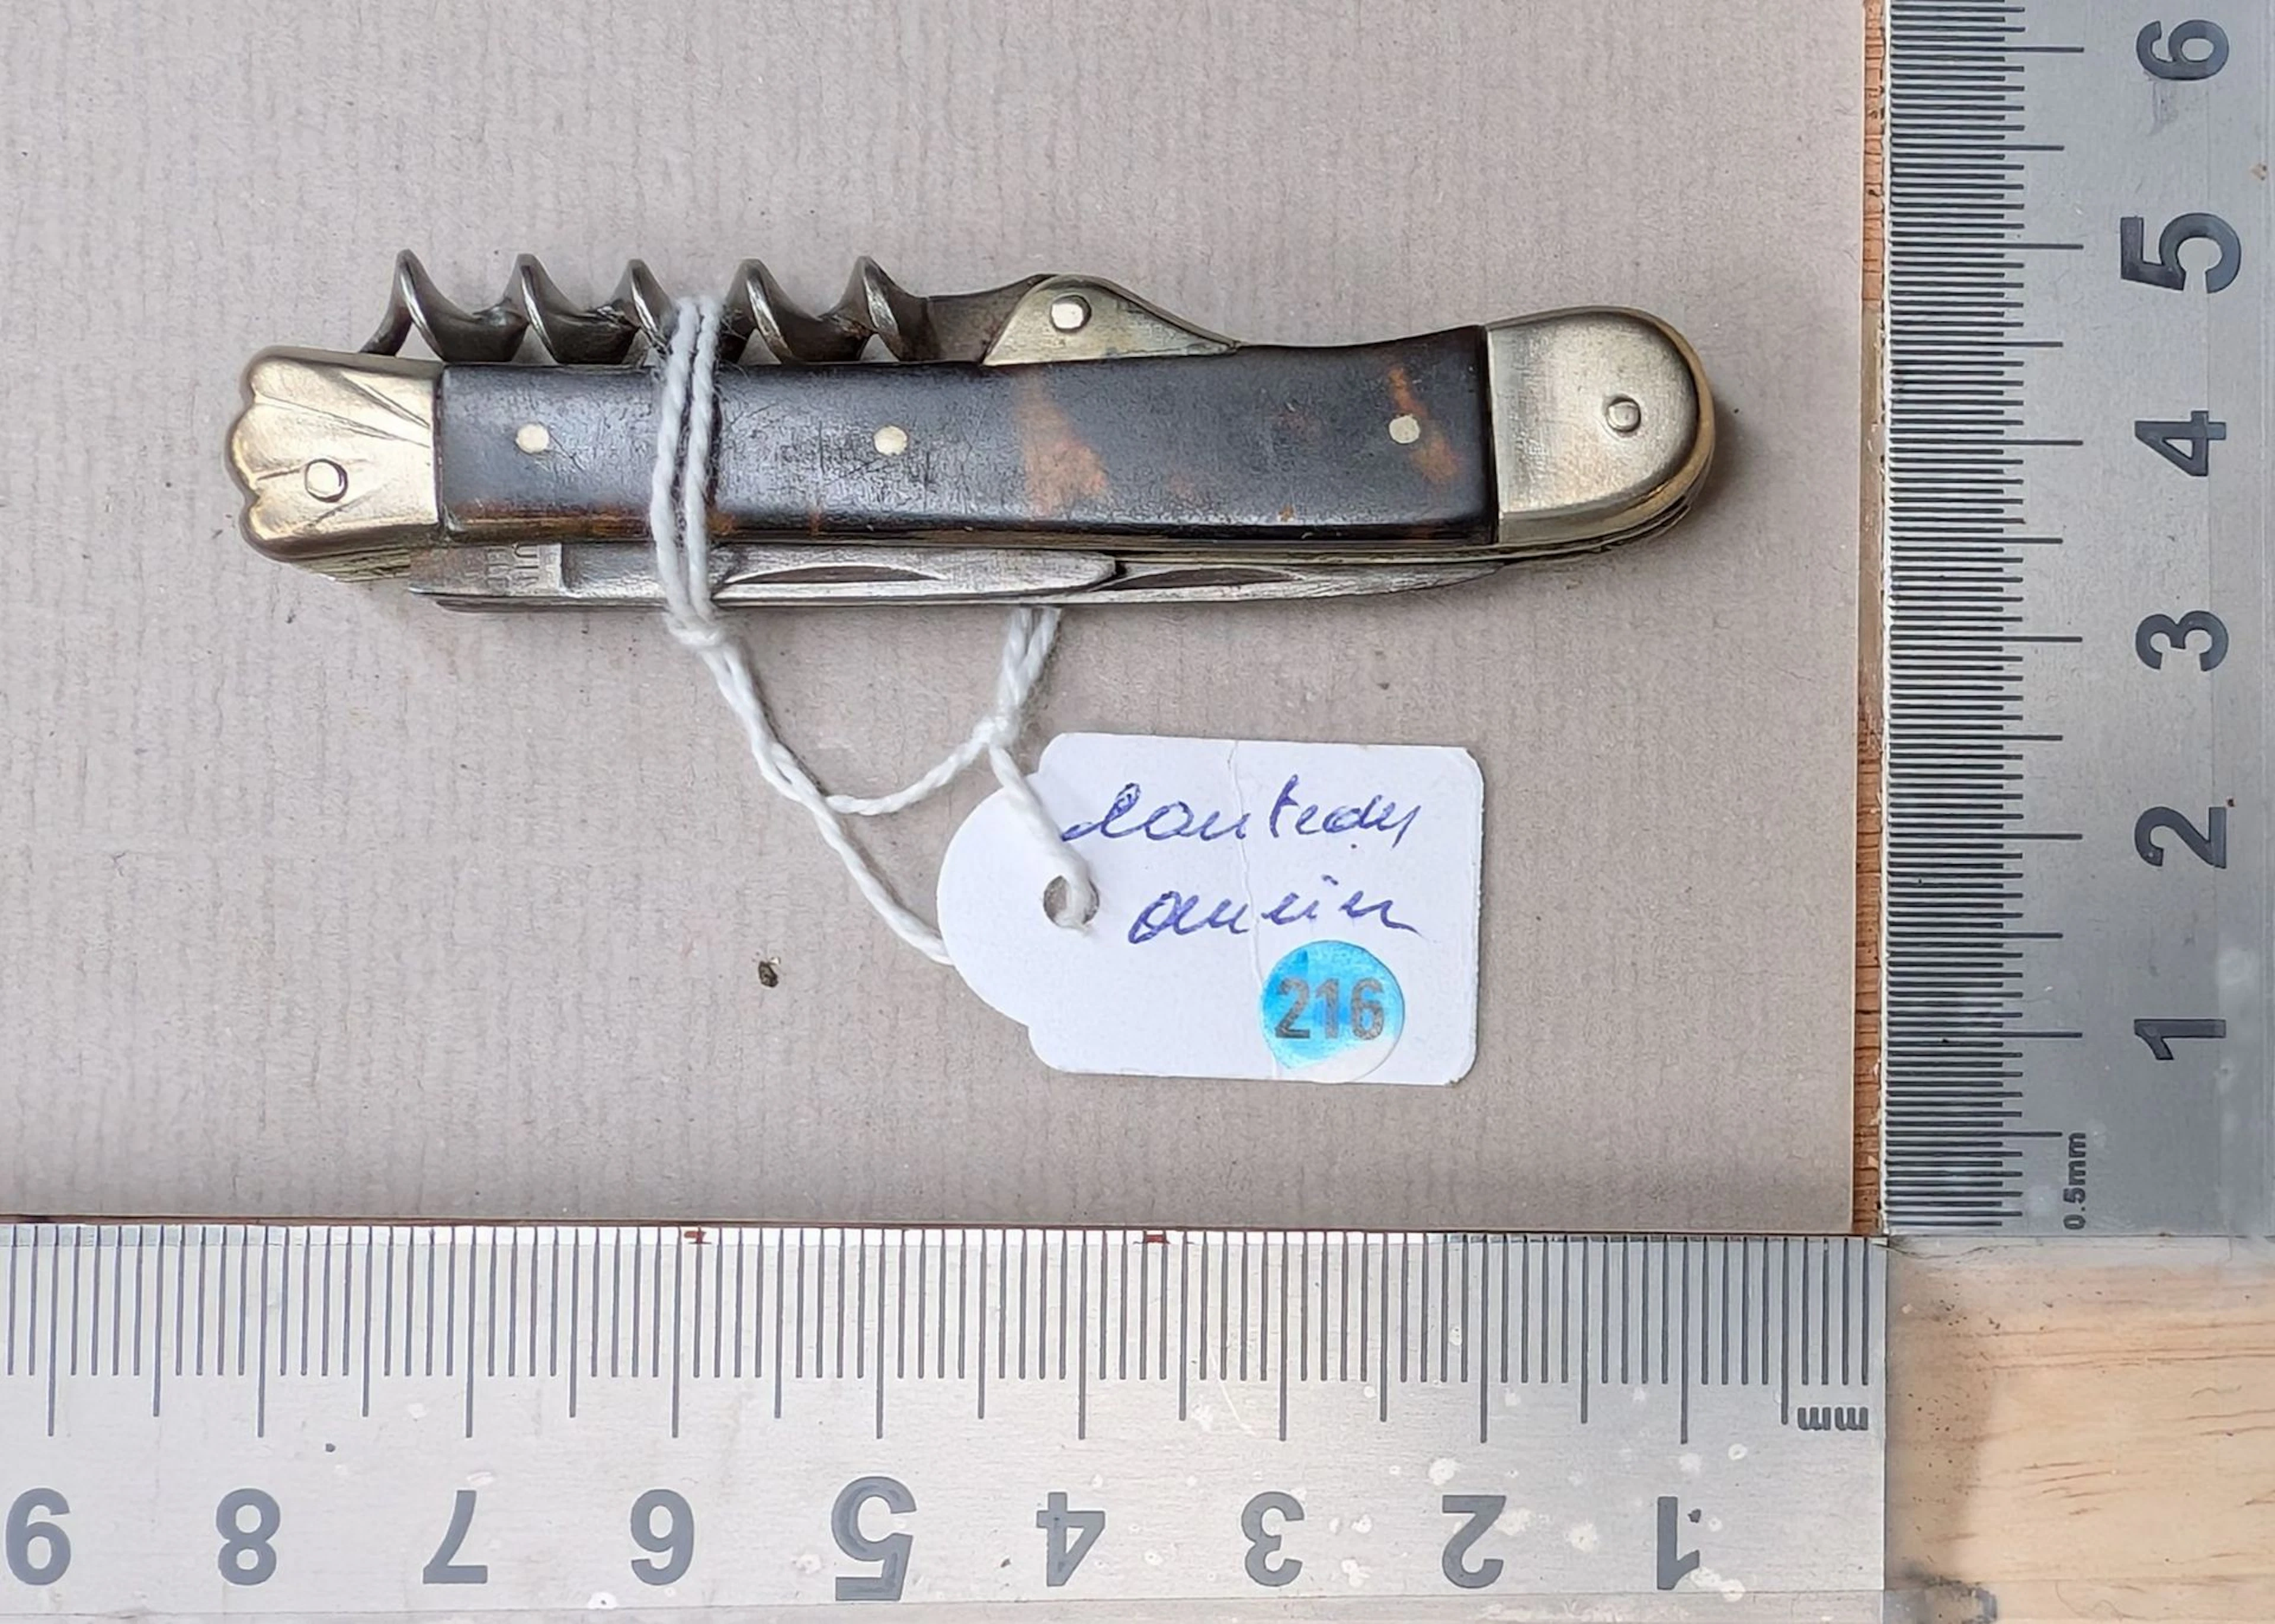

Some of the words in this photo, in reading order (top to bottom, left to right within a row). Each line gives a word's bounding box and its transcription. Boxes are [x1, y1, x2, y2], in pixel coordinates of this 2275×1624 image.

[2136, 20, 2229, 80] 6
[2120, 212, 2242, 294] 5
[2135, 410, 2226, 476] 4
[2135, 610, 2229, 671] 3
[2135, 807, 2227, 869] 2
[1274, 977, 1385, 1040] 216
[2134, 1018, 2227, 1060] 1
[2063, 1131, 2087, 1230] 0.5mm
[1797, 1406, 1869, 1431] mm
[5, 1487, 72, 1586] 9
[216, 1487, 281, 1586] 8
[422, 1490, 488, 1584] 7
[630, 1488, 694, 1586] 6
[831, 1475, 917, 1601] 5
[1036, 1491, 1106, 1587] 4
[1241, 1490, 1305, 1587] 3
[1442, 1494, 1507, 1588] 2
[1656, 1495, 1700, 1590] 1
